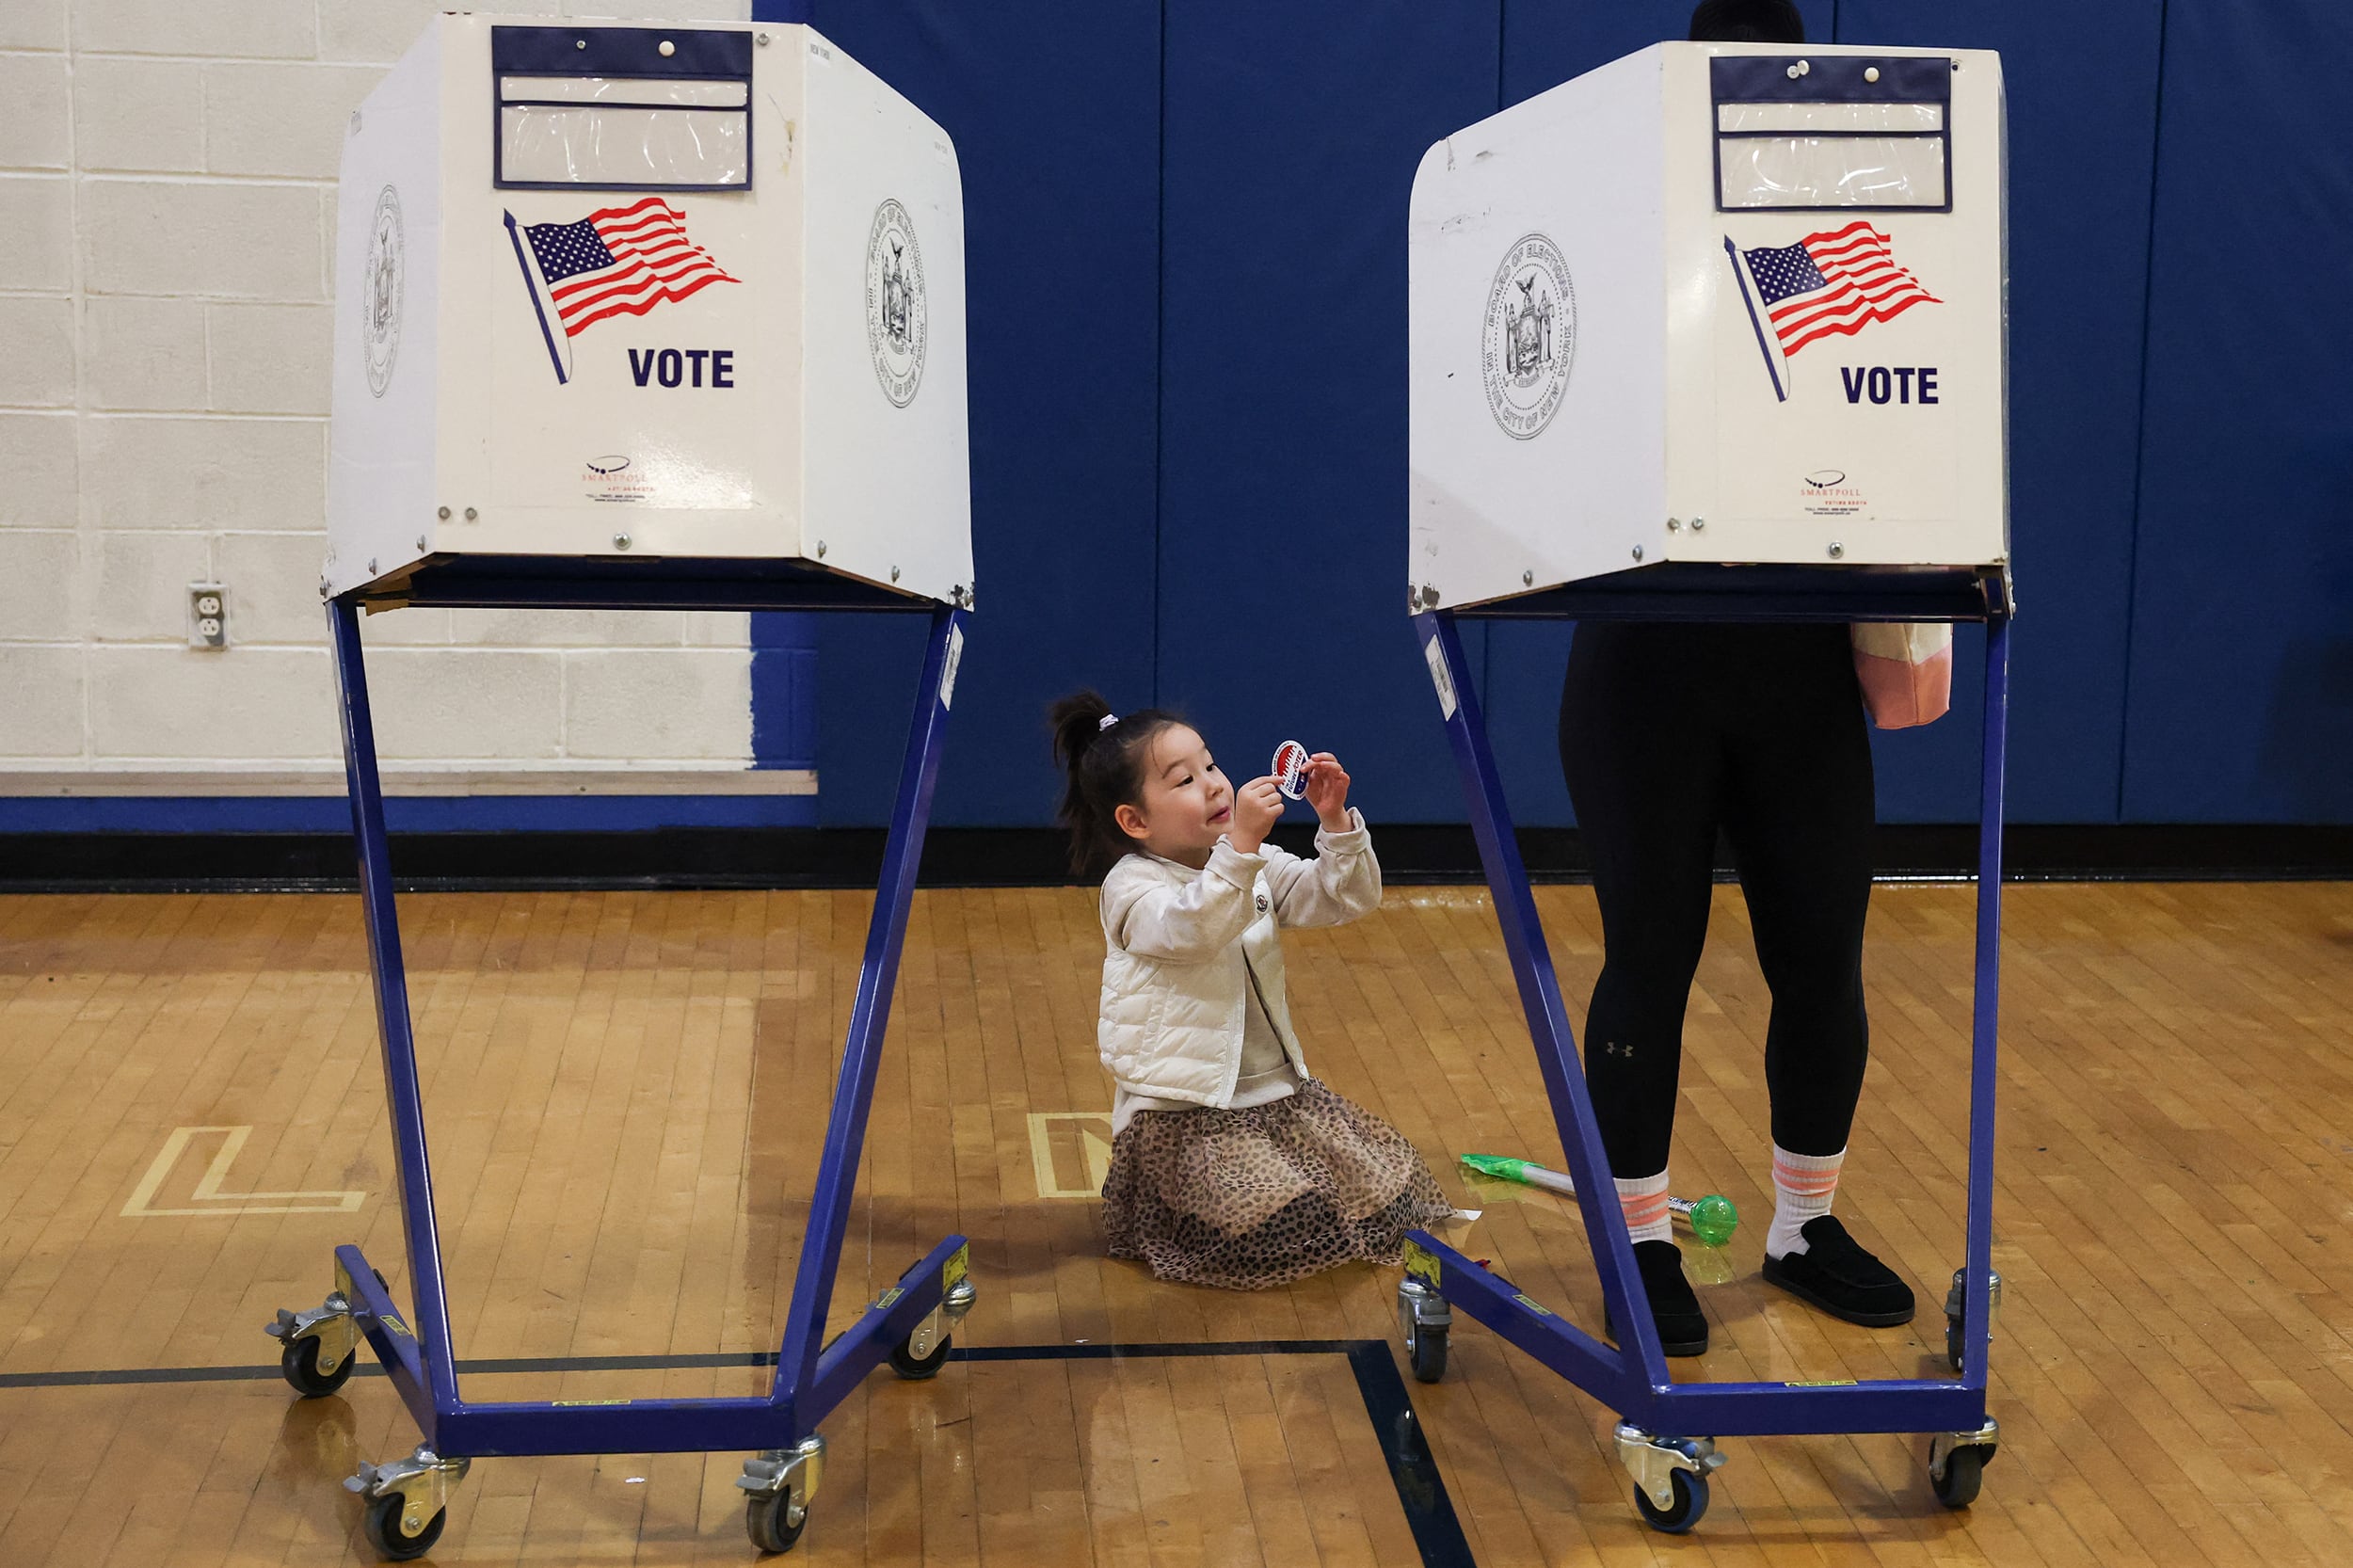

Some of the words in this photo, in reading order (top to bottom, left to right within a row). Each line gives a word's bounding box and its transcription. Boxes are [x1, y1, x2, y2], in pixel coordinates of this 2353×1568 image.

[1487, 264, 1511, 327] BOARD
[1512, 248, 1524, 267] OF
[1527, 244, 1568, 301] ELECTIONS
[628, 348, 734, 388] VOTE
[1840, 366, 1939, 405] VOTE
[1503, 407, 1525, 430] CITY
[1526, 411, 1538, 429] OF
[1800, 488, 1861, 497] SMARTPOLL
